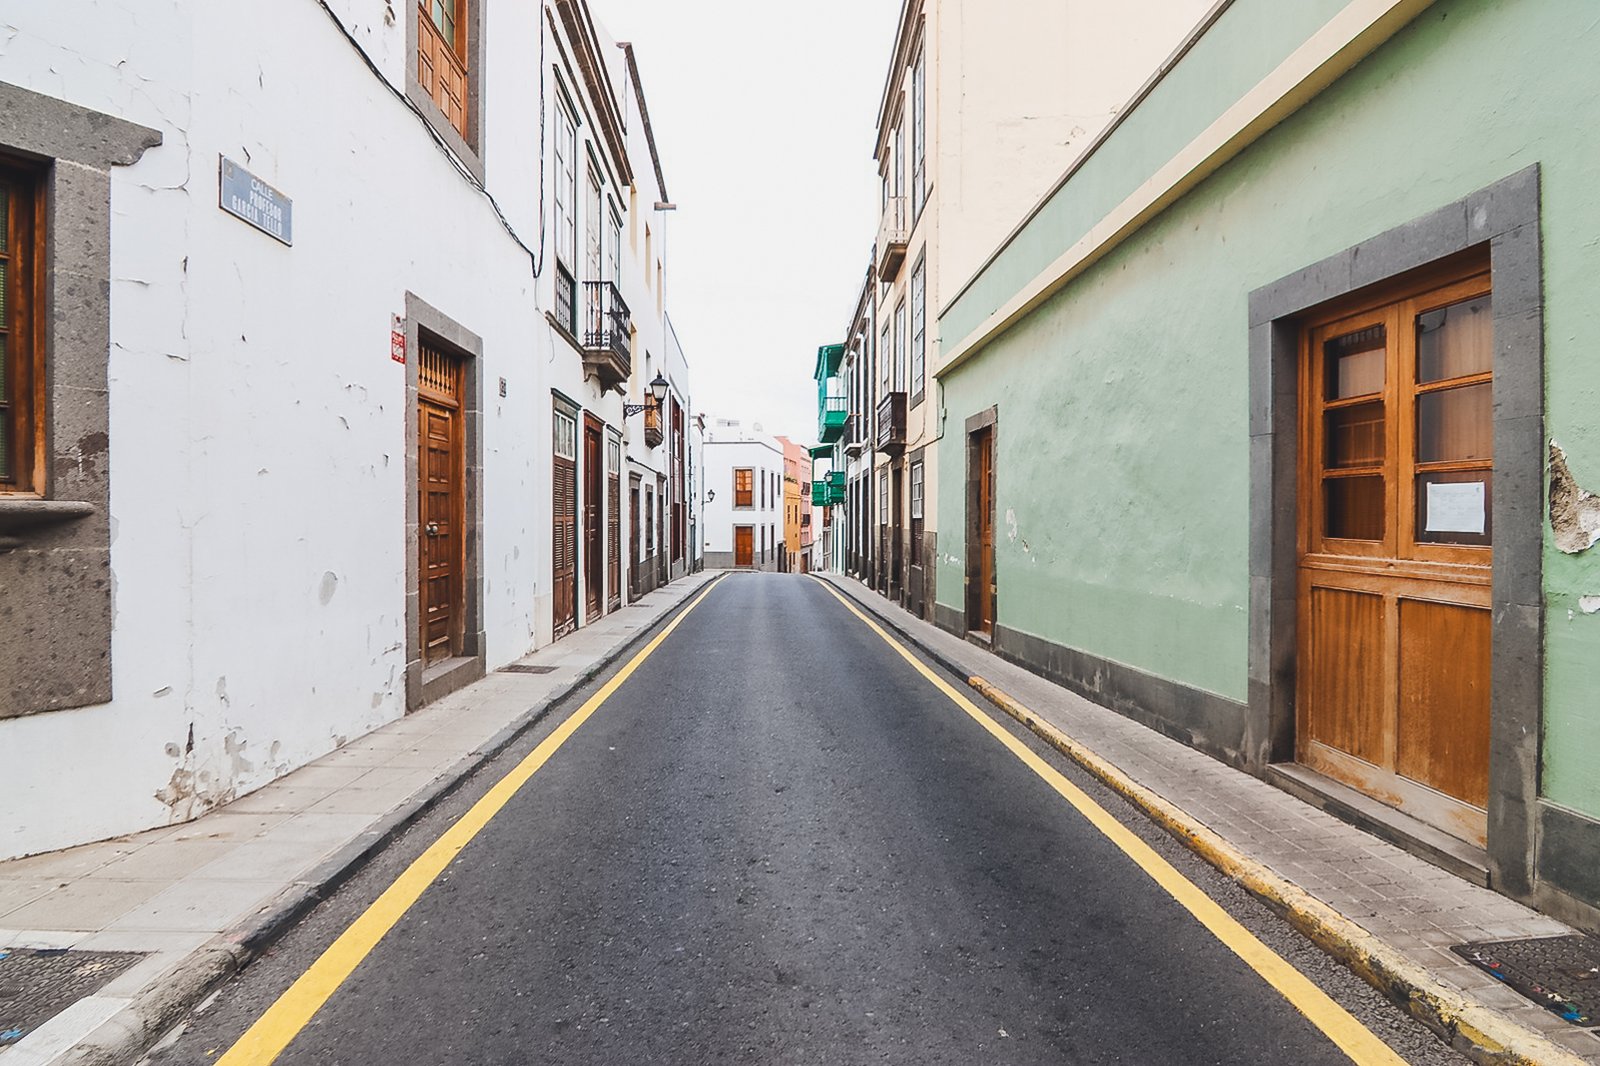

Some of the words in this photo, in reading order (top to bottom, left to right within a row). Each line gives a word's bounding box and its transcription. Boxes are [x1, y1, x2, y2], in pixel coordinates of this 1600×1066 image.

[251, 179, 273, 201] CALLE
[249, 190, 282, 222] PROFESOR
[262, 213, 282, 236] TELLO
